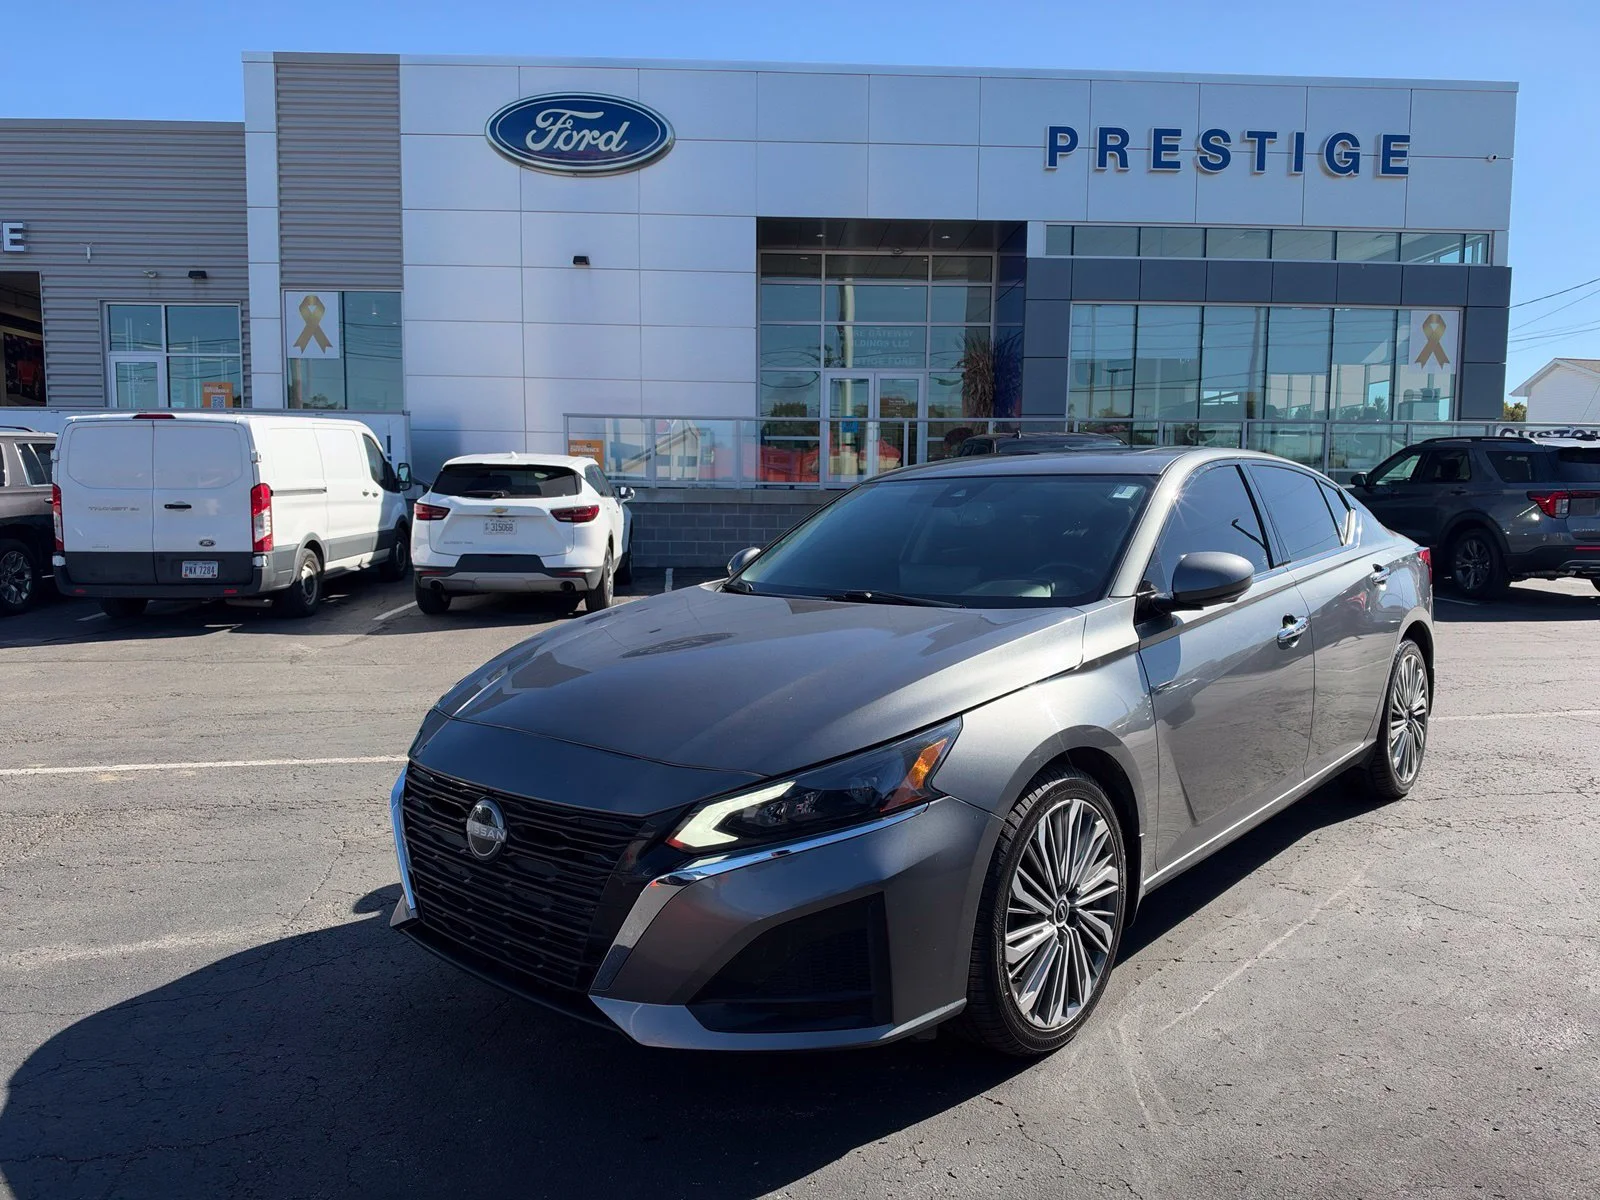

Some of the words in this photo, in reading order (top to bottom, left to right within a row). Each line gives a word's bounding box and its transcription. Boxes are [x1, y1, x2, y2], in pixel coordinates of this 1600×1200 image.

[525, 108, 631, 153] Ford
[1044, 124, 1411, 177] PRESTIGE
[868, 329, 914, 337] GATEWAY
[892, 339, 910, 348] LLC
[198, 565, 215, 575] 7284
